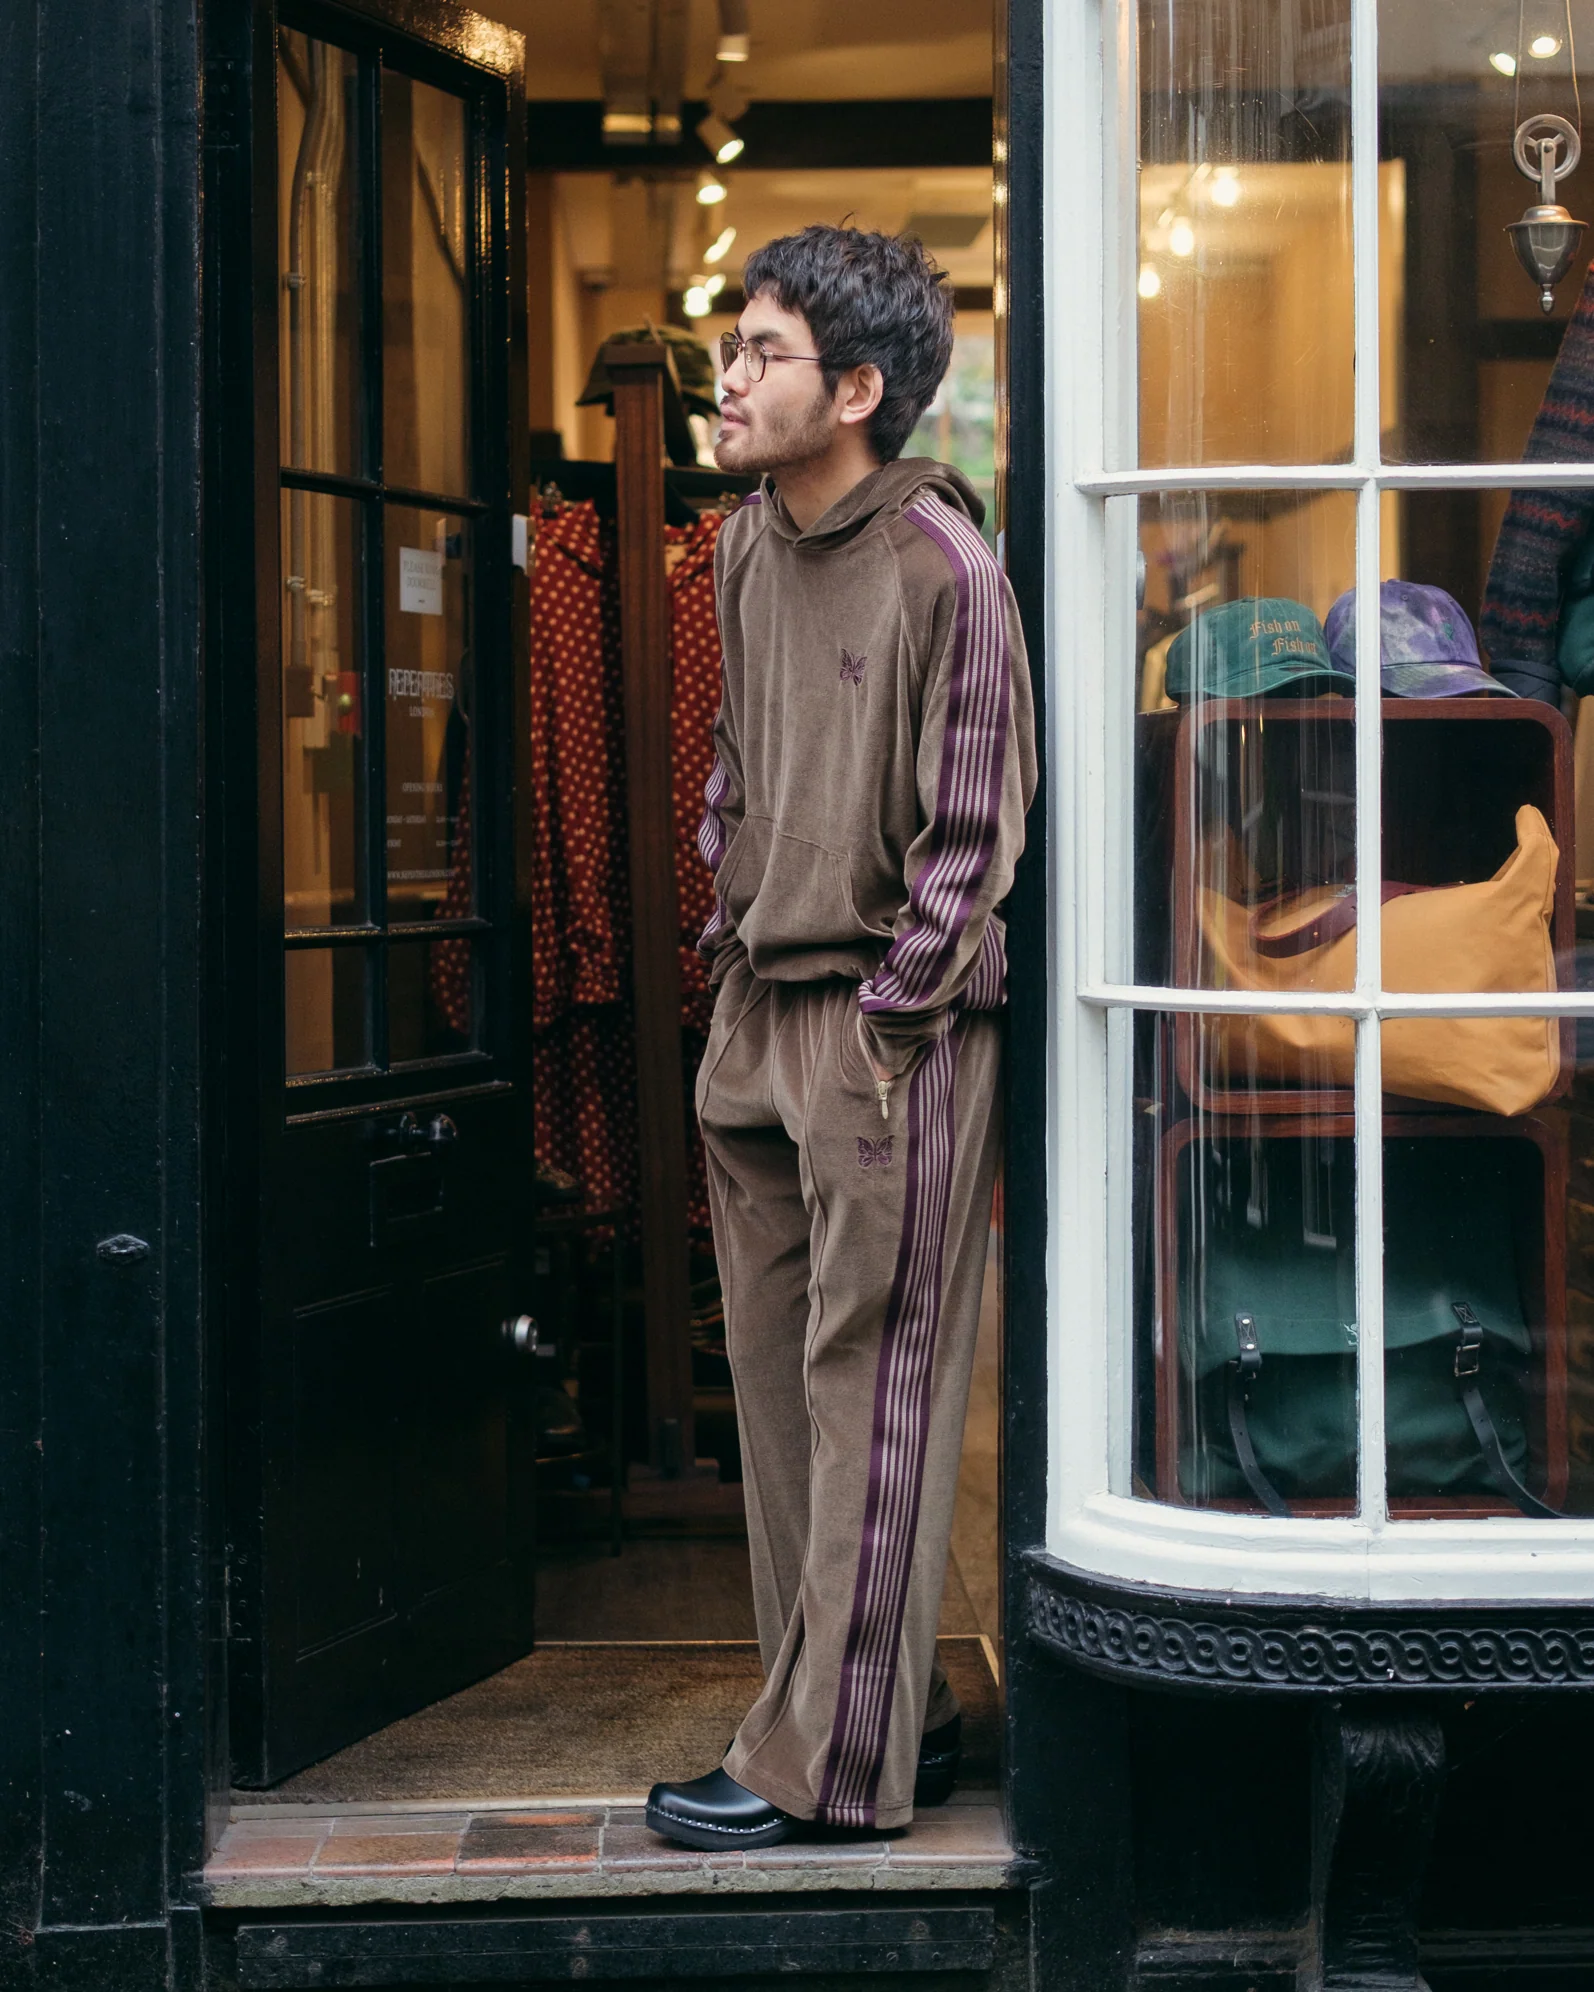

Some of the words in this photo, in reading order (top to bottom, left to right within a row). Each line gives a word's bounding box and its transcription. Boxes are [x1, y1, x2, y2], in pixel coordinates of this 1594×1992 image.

[1250, 619, 1283, 639] Fish
[1284, 620, 1301, 632] on
[1271, 636, 1304, 656] Fish
[1305, 642, 1317, 655] on
